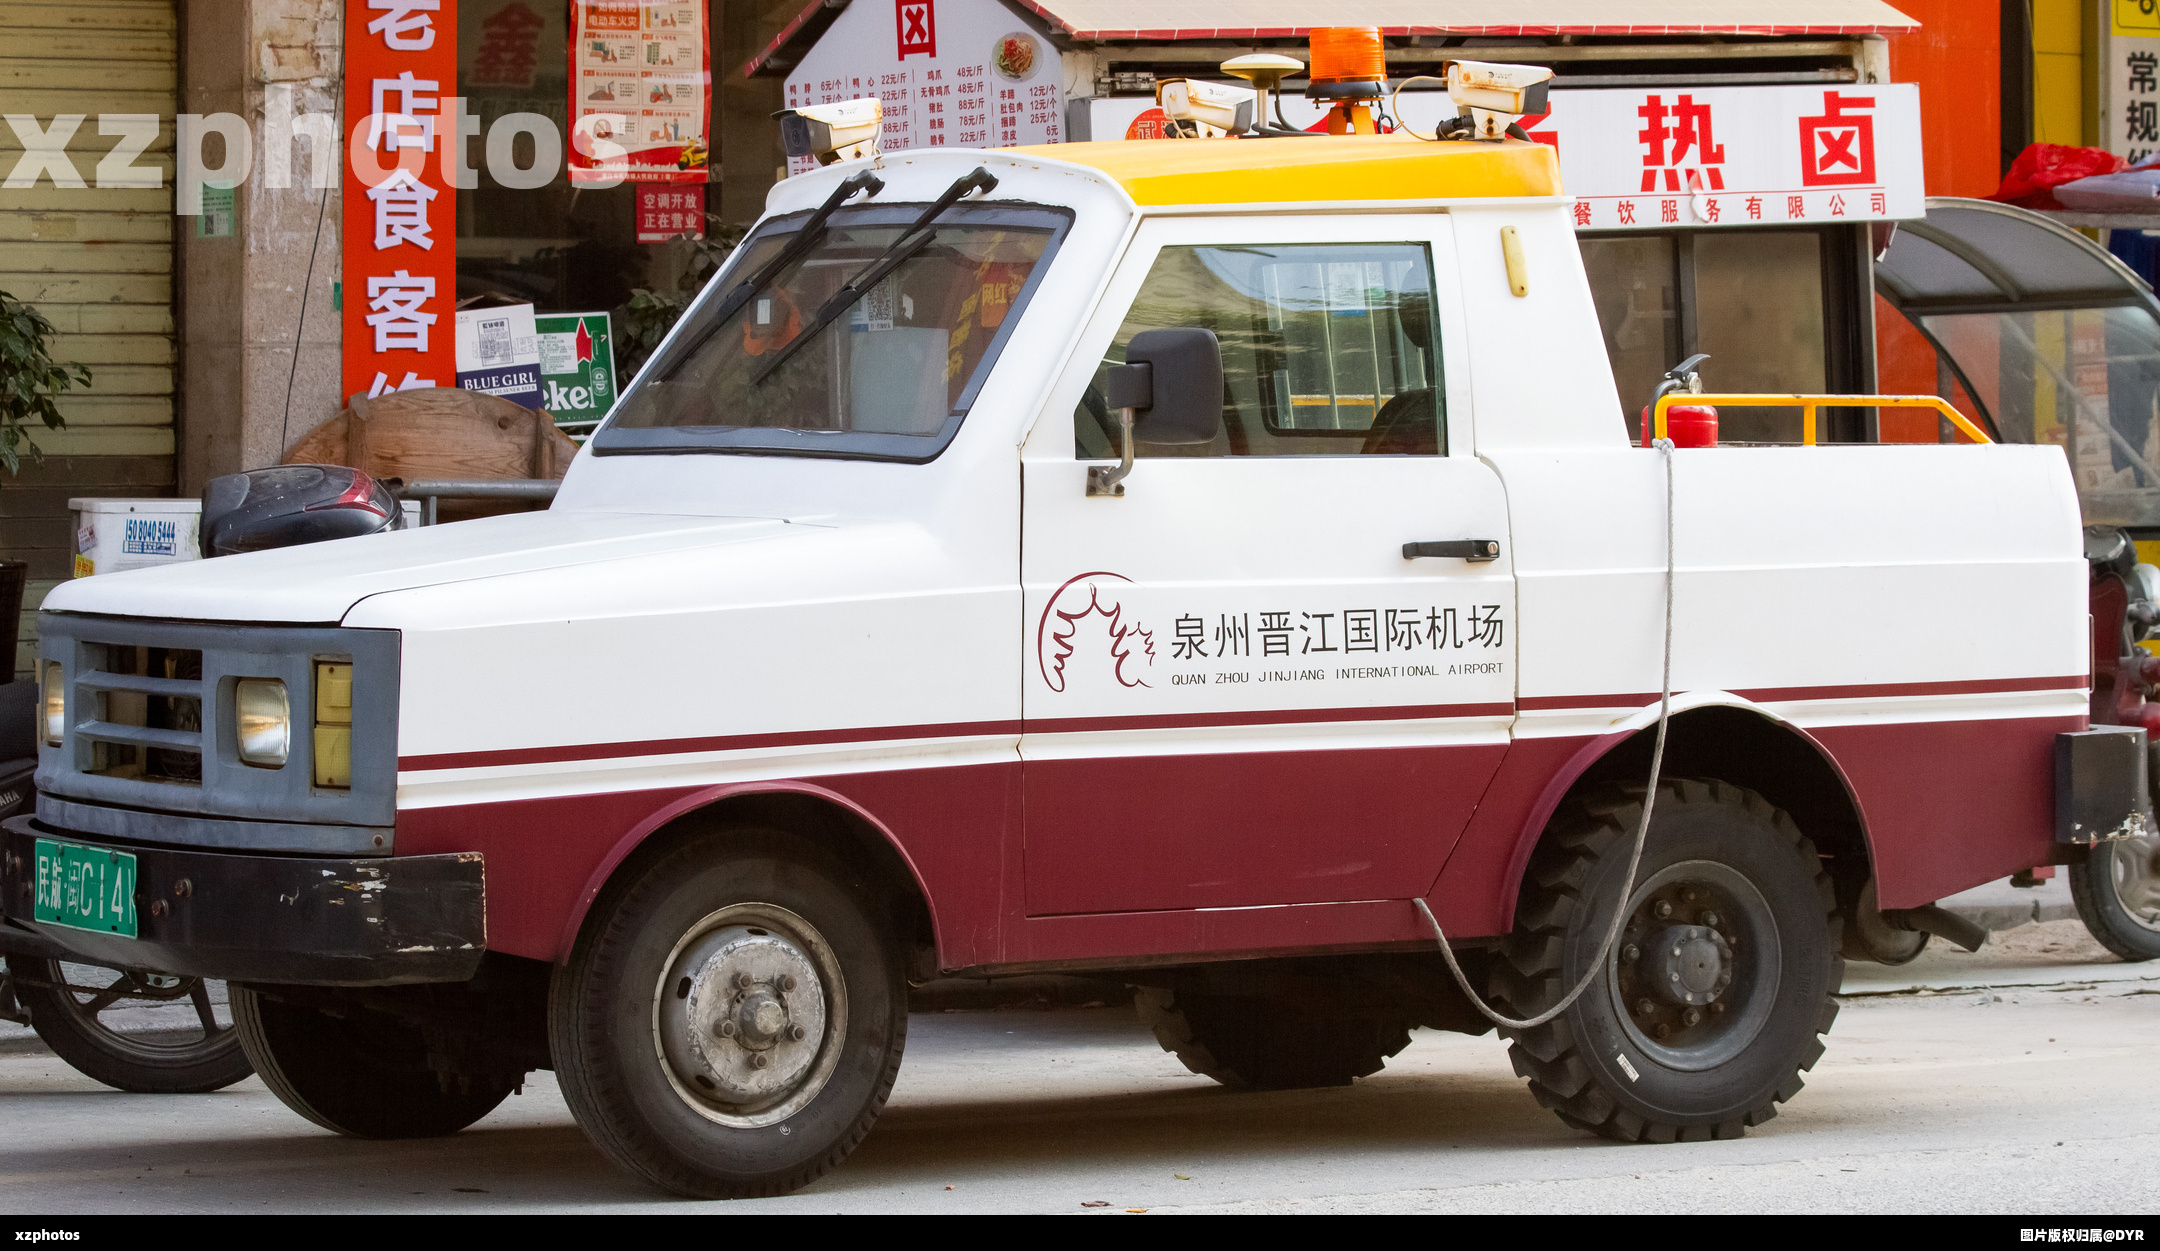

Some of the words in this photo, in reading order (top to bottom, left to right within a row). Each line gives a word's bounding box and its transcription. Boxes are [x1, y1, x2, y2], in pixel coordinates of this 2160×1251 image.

[588, 15, 637, 27] 电动车火灾
[881, 72, 907, 85] 22元/斤
[927, 69, 943, 81] 鸡爪
[957, 65, 984, 78] 48元/斤
[820, 79, 842, 91] 6元/个
[920, 85, 951, 98] 无骨鸡爪
[957, 81, 984, 94] 48元/斤
[1029, 84, 1057, 97] 12元/个
[881, 88, 908, 101] 22元/斤
[882, 105, 908, 117] 88元/斤
[958, 97, 985, 110] 88元/斤
[1000, 101, 1023, 114] 肚包肉
[1030, 97, 1057, 110] 12元/个
[959, 114, 985, 127] 78元/斤
[1030, 110, 1058, 124] 25元/个
[883, 120, 909, 133] 68元/斤
[1002, 129, 1017, 141] 凉皮
[1046, 125, 1058, 136] 6元
[883, 136, 910, 149] 22元/斤
[959, 130, 987, 143] 22元/斤
[366, 0, 440, 400] 老店食客
[643, 193, 697, 210] 空调开放
[1573, 192, 1887, 227] 餐饮服务有限公司
[643, 212, 697, 229] 正在营业
[464, 375, 500, 391] BLUE
[502, 371, 537, 387] GIRL
[157, 520, 176, 543] 5444
[1171, 604, 1503, 660] 泉州晋江国际机场
[1171, 673, 1206, 686] QUAN
[1215, 672, 1249, 684] ZHOU
[1258, 669, 1325, 682] JINJIANG
[1336, 665, 1440, 679] INTERNATIONAL
[1448, 662, 1503, 675] AIRPORT
